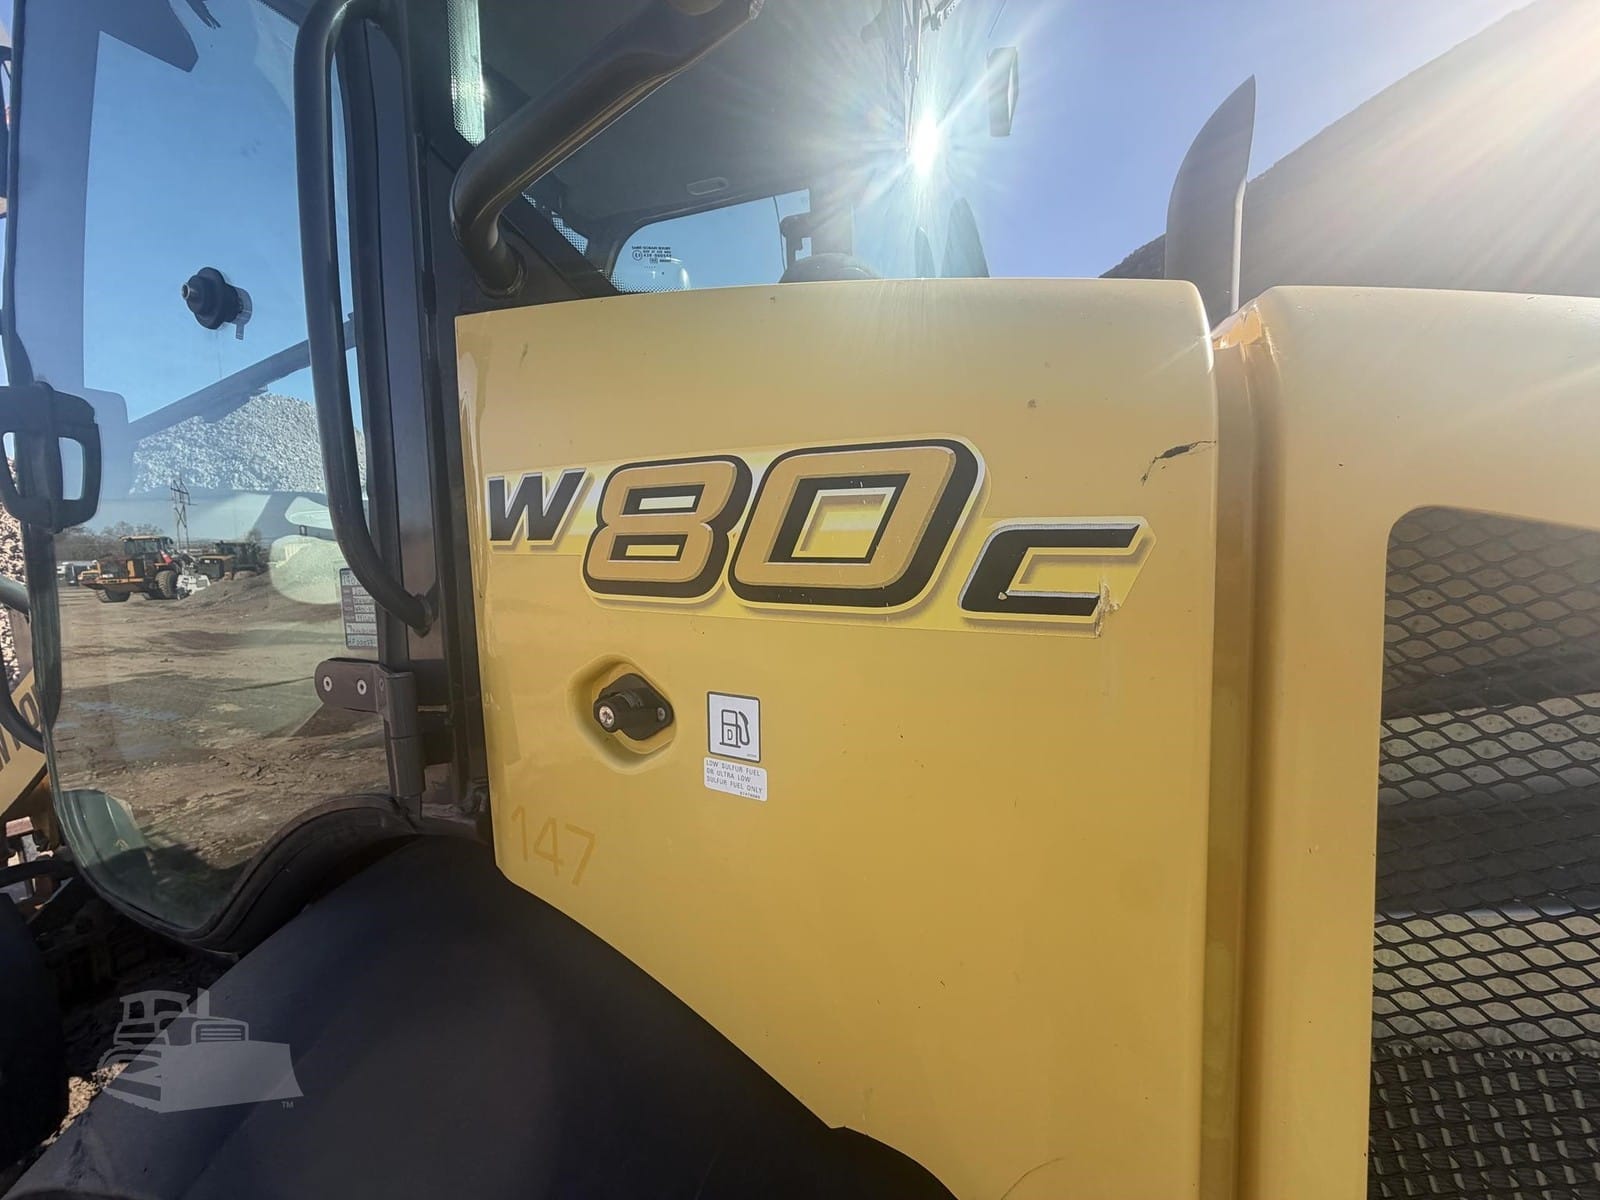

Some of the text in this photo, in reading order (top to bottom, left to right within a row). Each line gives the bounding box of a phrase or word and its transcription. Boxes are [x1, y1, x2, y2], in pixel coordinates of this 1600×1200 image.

[706, 759, 761, 777] LOW SULFUR FUEL
[706, 767, 752, 783] OR ULTRA LOW
[706, 775, 763, 794] SULFUR FUEL ONLY
[511, 804, 596, 887] 147
